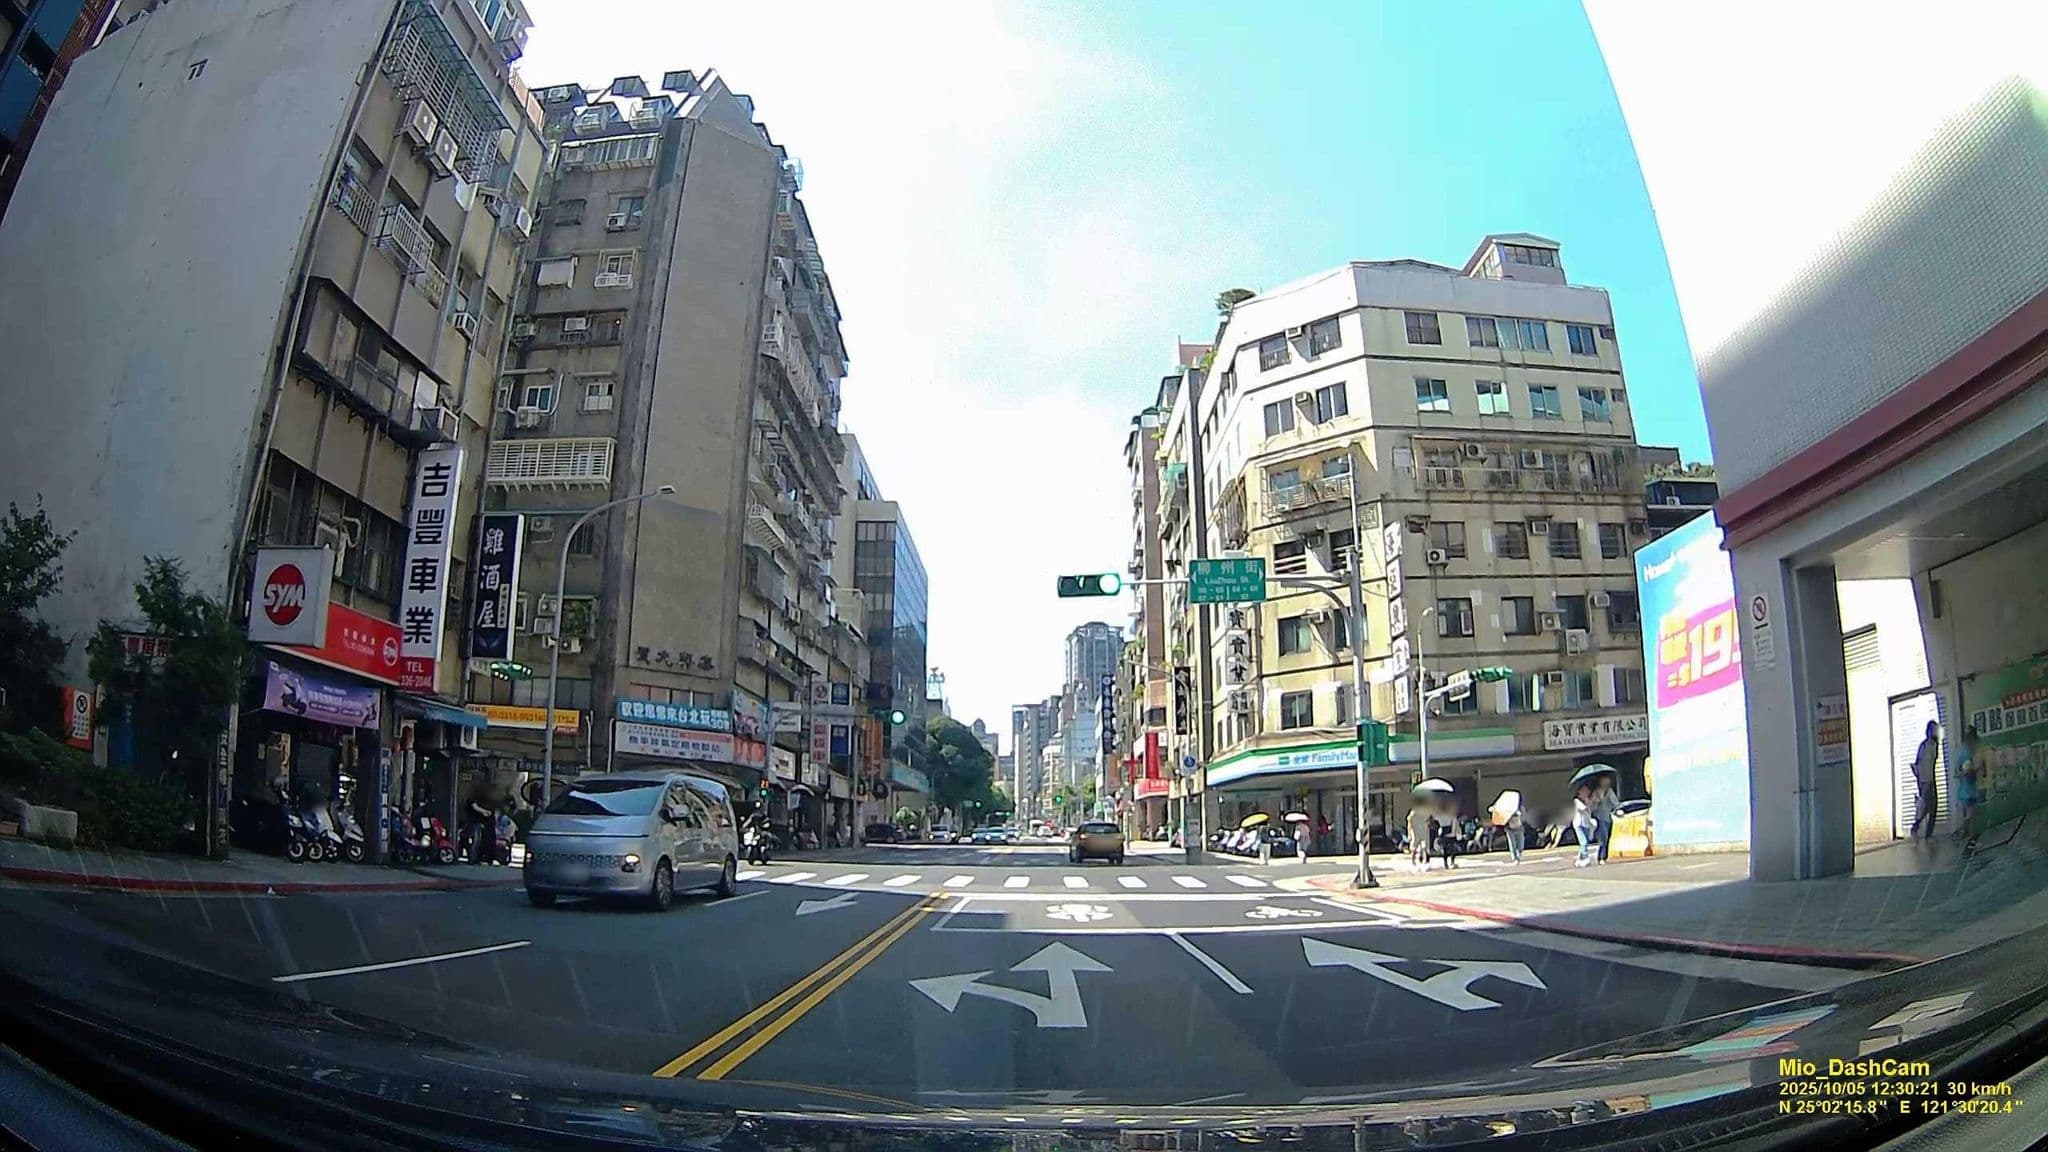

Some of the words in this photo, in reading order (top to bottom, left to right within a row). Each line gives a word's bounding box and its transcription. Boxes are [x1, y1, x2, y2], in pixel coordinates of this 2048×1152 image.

[403, 462, 451, 644] 吉豐車業
[264, 583, 303, 614] SYM
[406, 660, 425, 674] TEL
